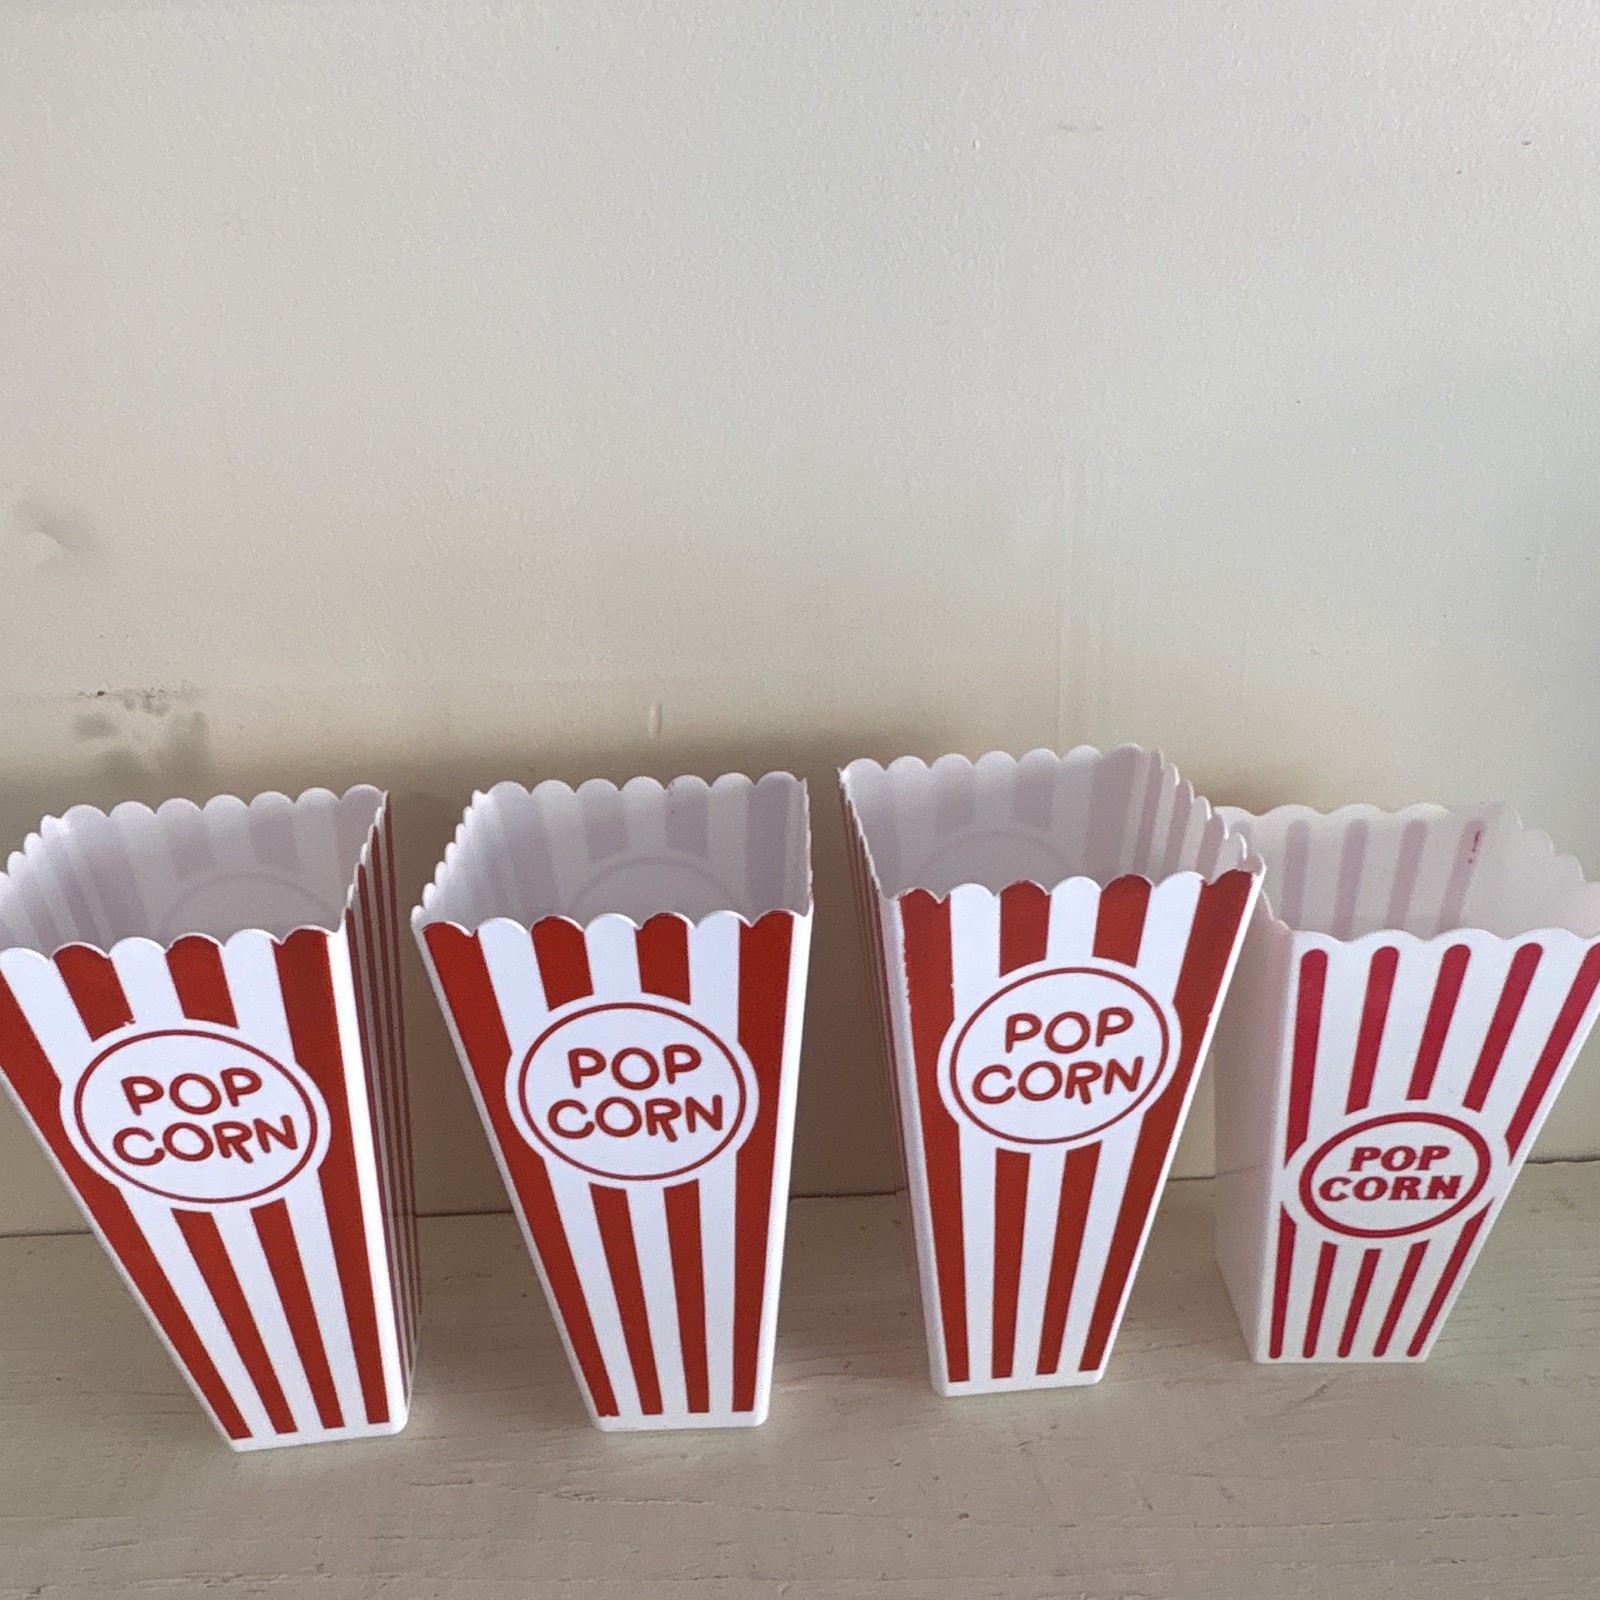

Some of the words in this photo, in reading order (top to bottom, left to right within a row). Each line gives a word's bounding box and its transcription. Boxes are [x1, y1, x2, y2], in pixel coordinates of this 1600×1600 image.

[1006, 1008, 1134, 1054] POP
[569, 1045, 702, 1091] POP
[972, 1057, 1144, 1105] CORN
[122, 1068, 262, 1116] POP
[113, 1116, 298, 1166] CORN
[547, 1095, 723, 1142] CORN
[1350, 1145, 1450, 1172] POP
[1319, 1175, 1462, 1202] CORN
